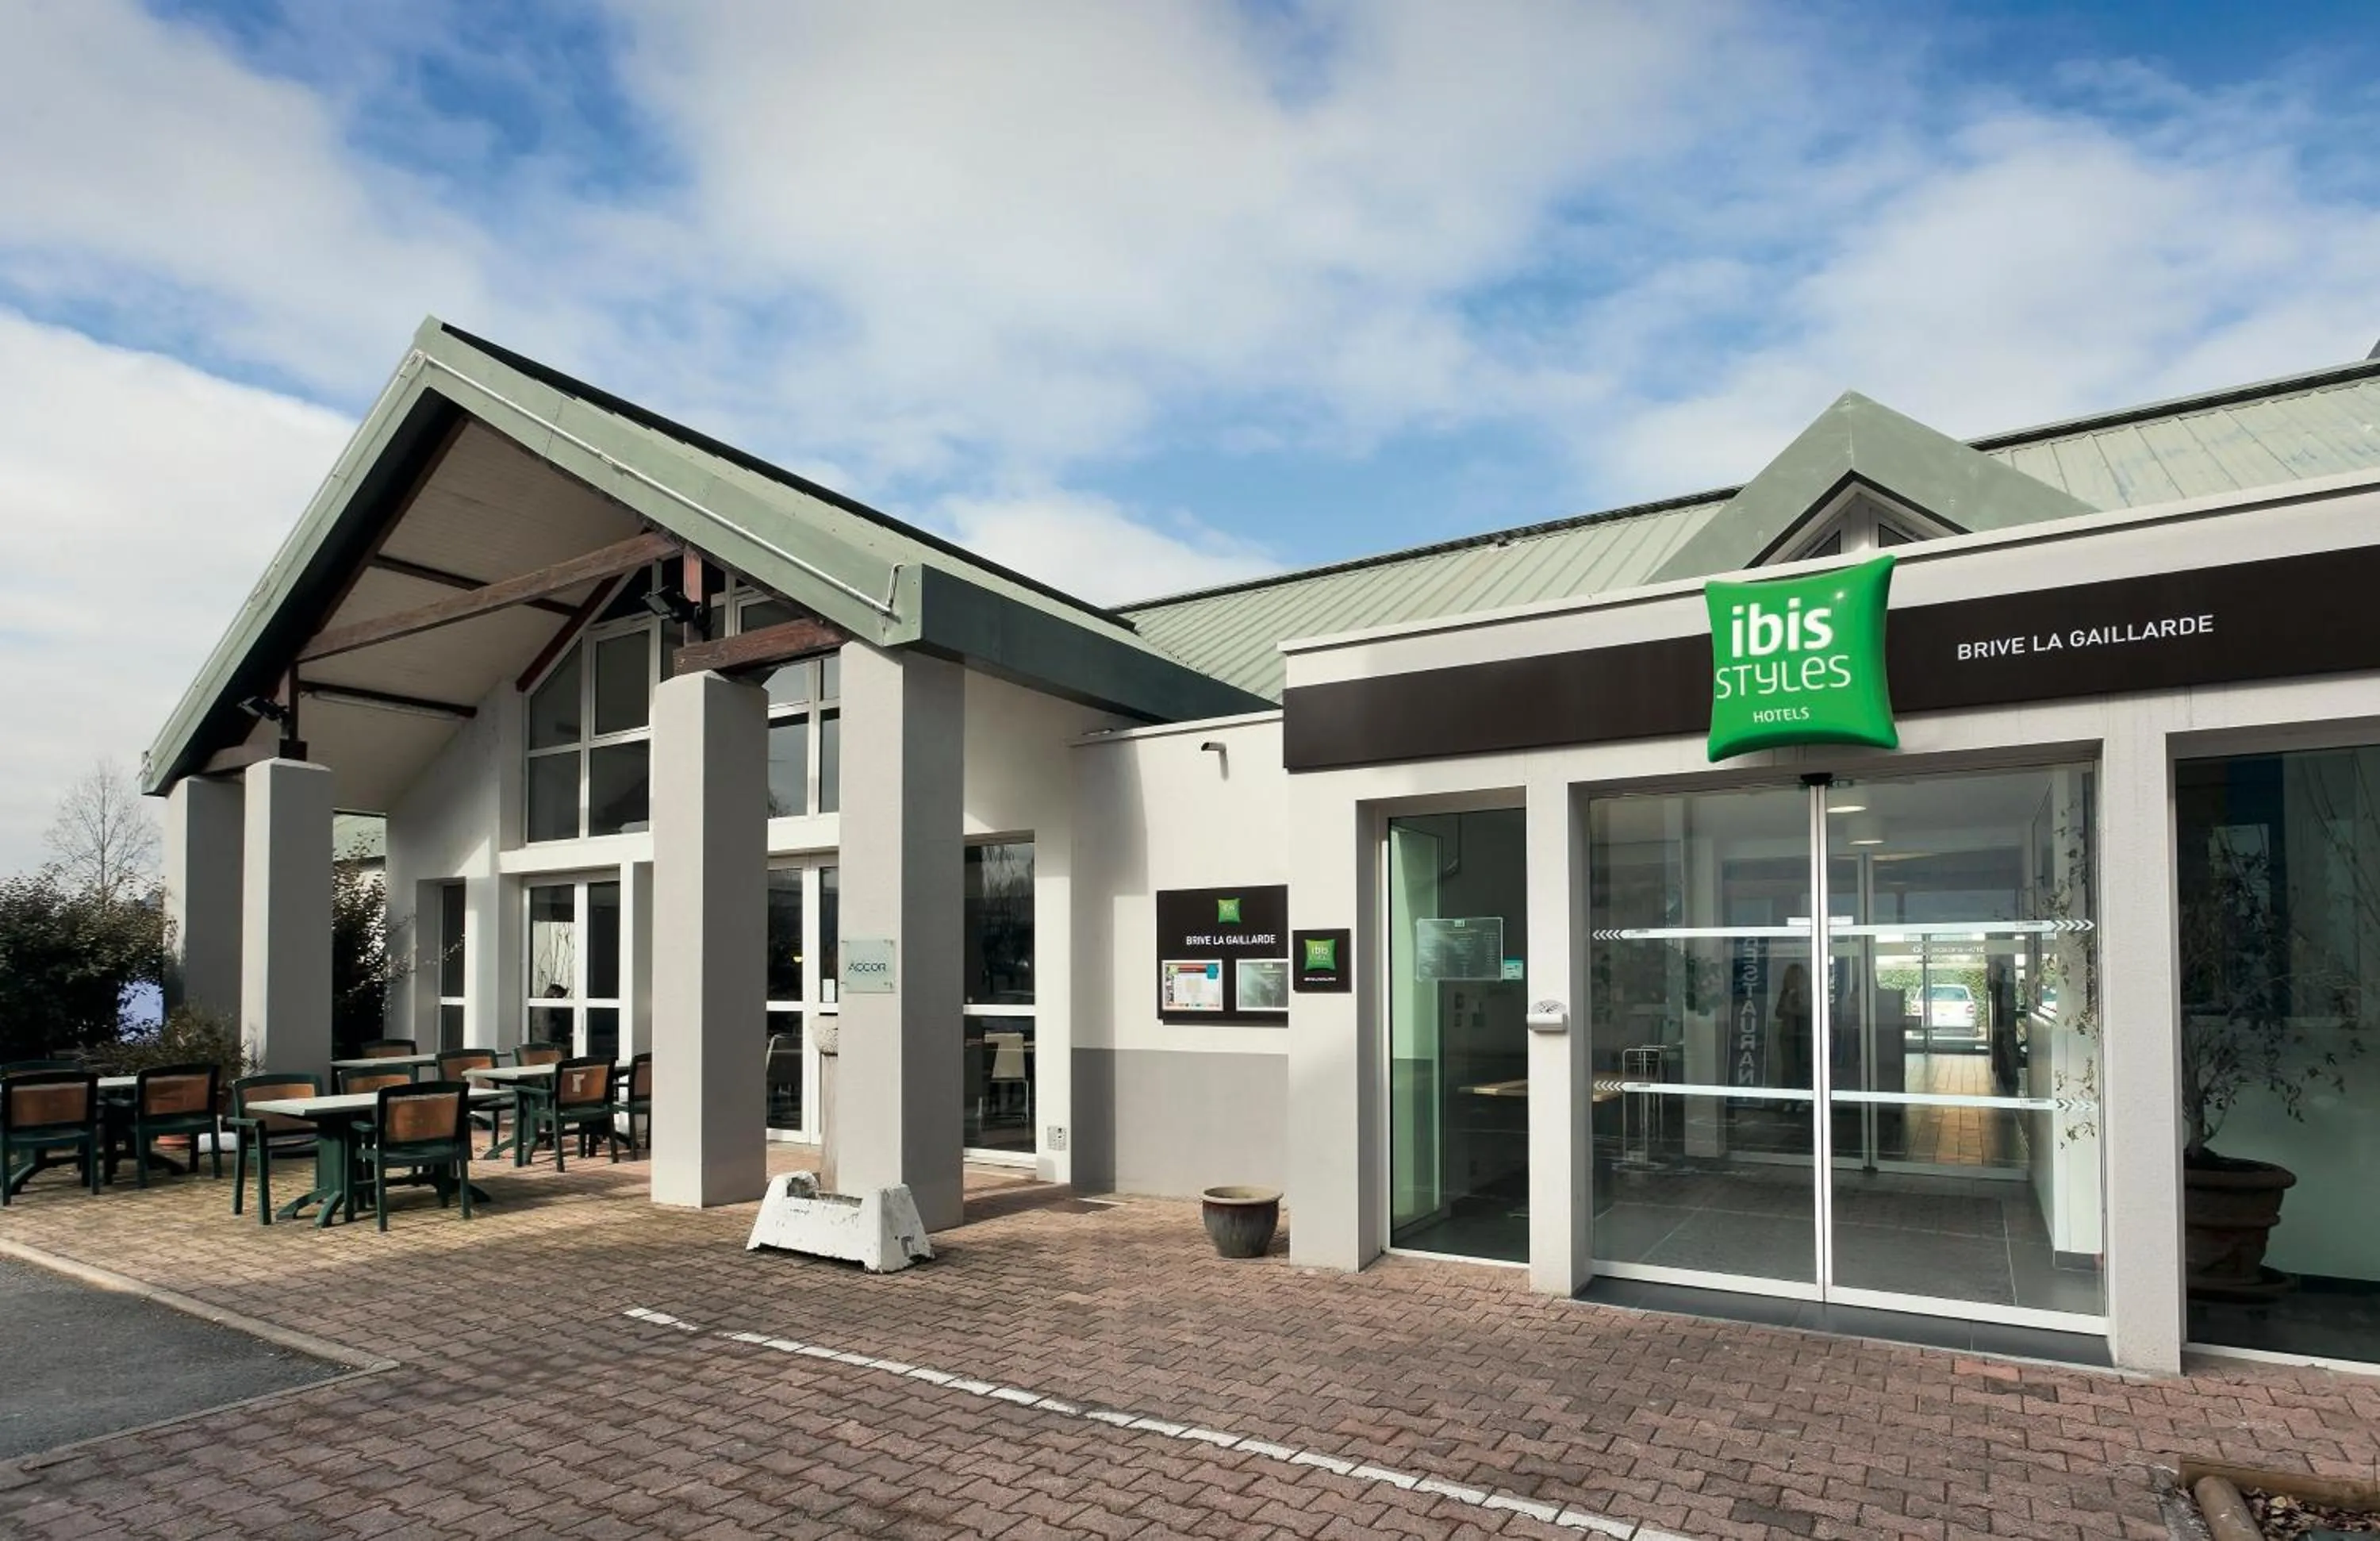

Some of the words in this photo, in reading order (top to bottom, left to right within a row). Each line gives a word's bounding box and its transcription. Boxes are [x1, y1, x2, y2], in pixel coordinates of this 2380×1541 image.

[1732, 597, 1833, 658] ibis
[1957, 636, 2025, 660] BRIVE
[2033, 633, 2063, 651] LA
[2069, 615, 2214, 648] GAILLARDE
[1752, 706, 1810, 723] HOTELS
[1186, 936, 1211, 945] BRIVE
[1213, 936, 1225, 945] LA
[1226, 934, 1276, 945] GAILLARDE
